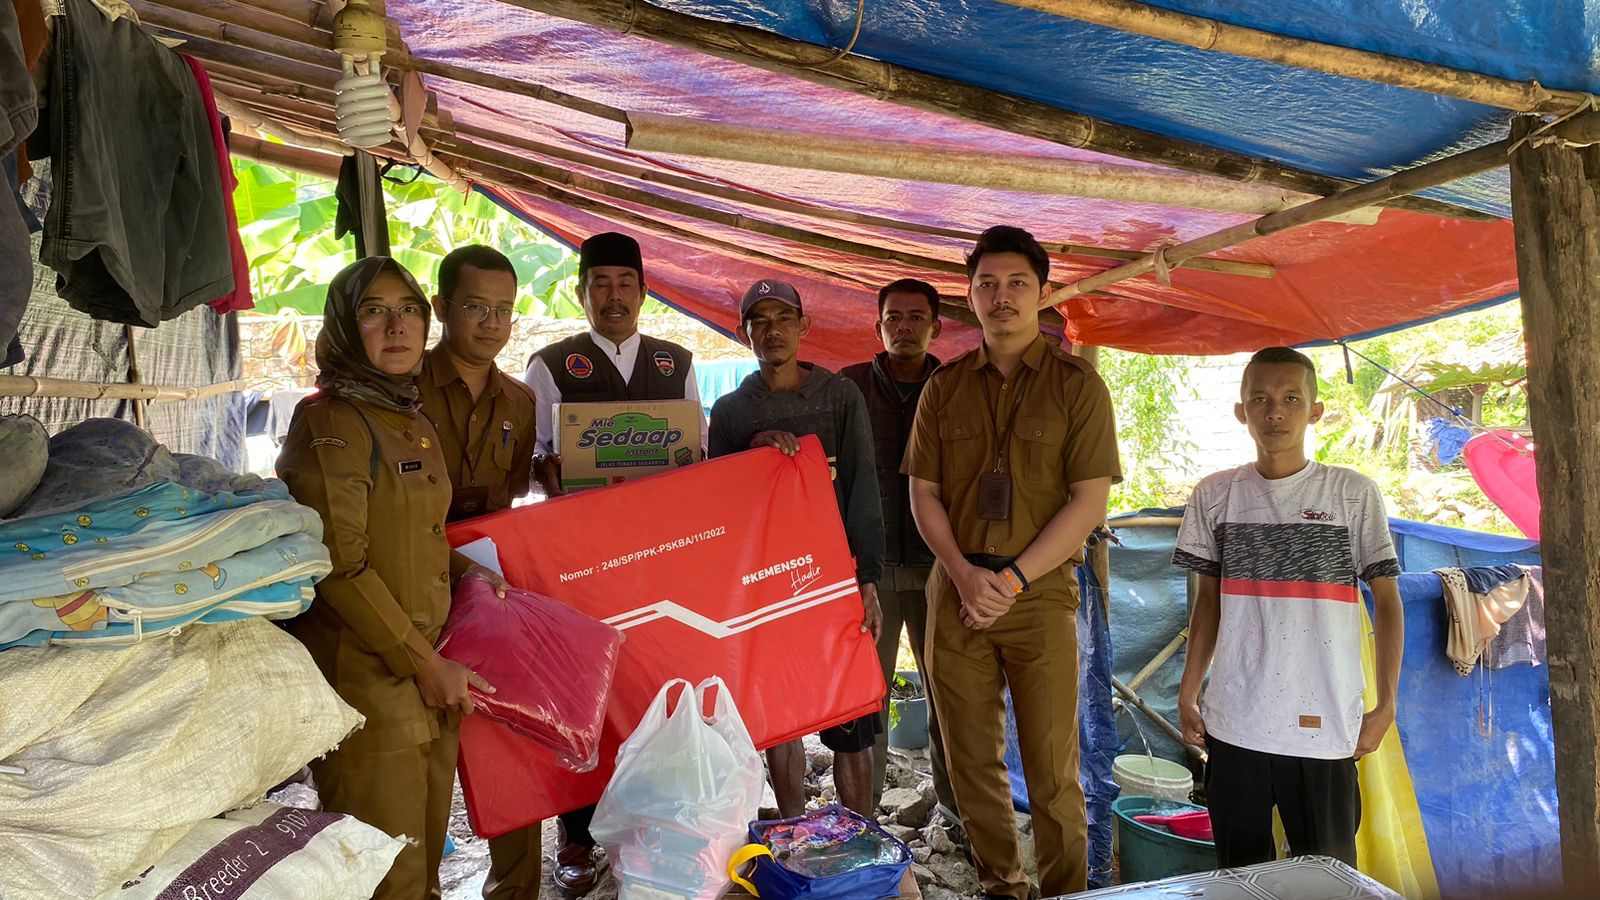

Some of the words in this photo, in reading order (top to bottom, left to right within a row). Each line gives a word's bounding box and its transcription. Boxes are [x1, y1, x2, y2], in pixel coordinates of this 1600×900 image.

[591, 418, 615, 428] Mie
[577, 426, 684, 449] Sedaap
[559, 566, 595, 583] Nomor
[601, 525, 727, 572] 248/SP/PPK-PSKBA/11/2022
[741, 554, 814, 586] #KEMENSOS
[790, 565, 822, 590] Hadir
